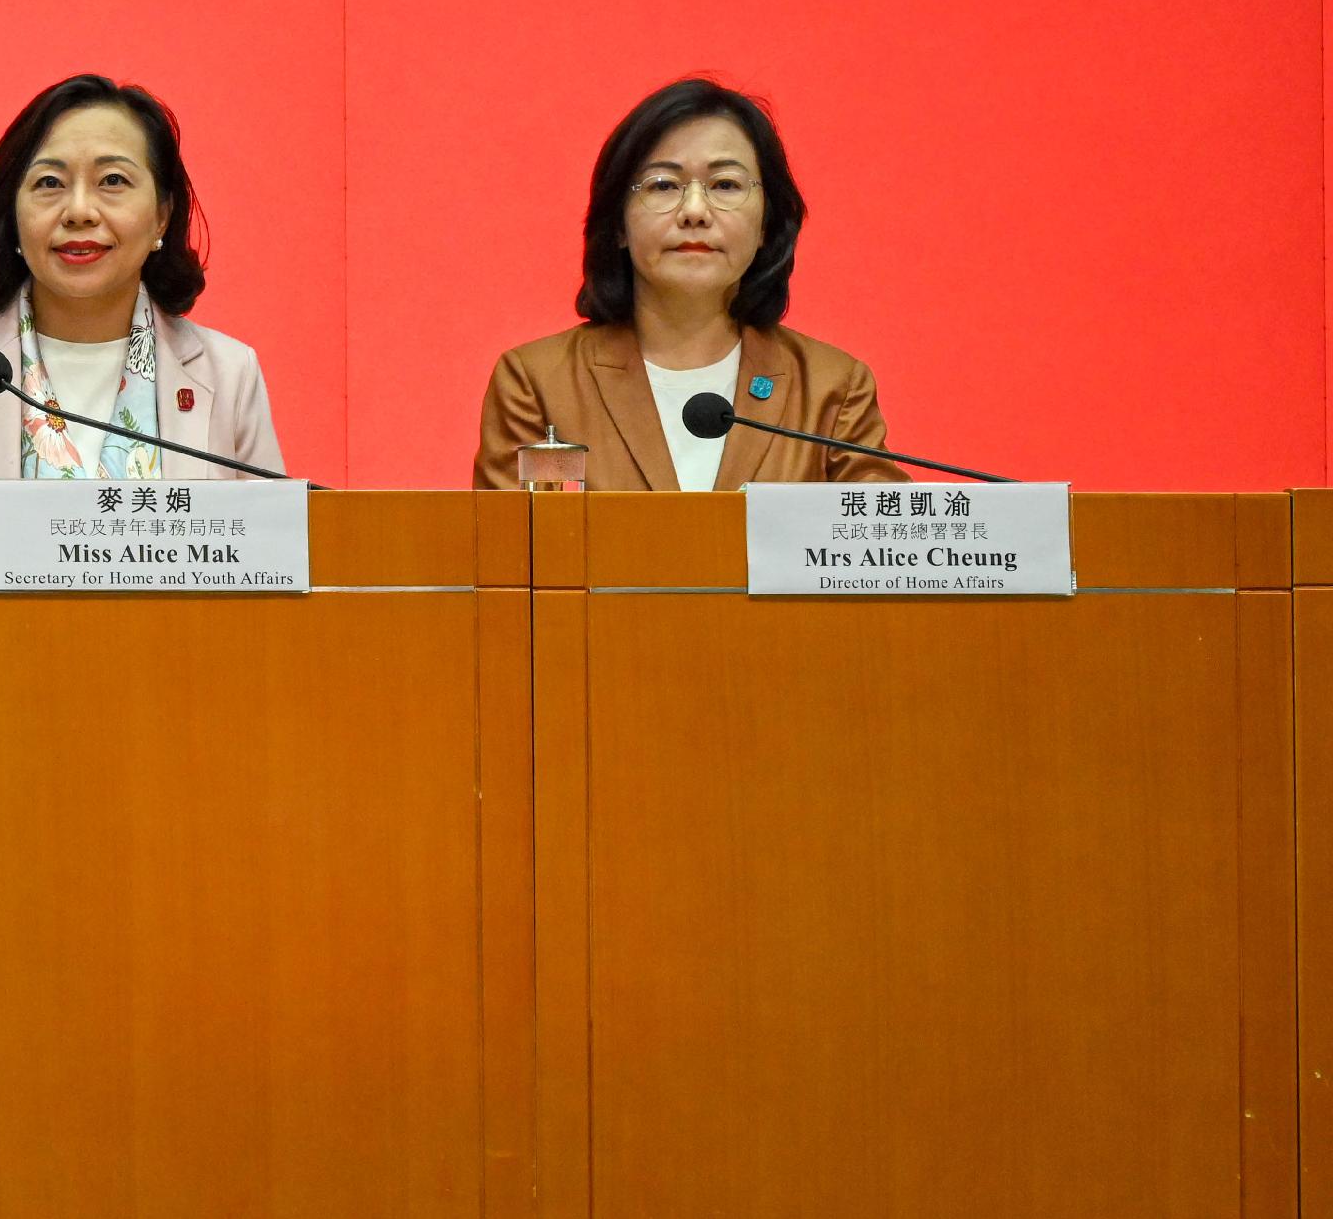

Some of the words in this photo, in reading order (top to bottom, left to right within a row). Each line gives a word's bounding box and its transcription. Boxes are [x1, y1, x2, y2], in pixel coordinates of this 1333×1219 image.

[96, 486, 192, 514] 麥美娟
[840, 490, 971, 517] 張趙凱渝
[50, 518, 246, 537] 民政及青年事務局局長
[832, 522, 989, 541] 民政事務總署署長
[58, 543, 112, 563] Miss
[118, 543, 178, 563] Alice
[186, 543, 240, 563] Mak
[804, 547, 852, 567] Mrs
[858, 547, 919, 567] Alice
[926, 547, 1018, 572] Cheung
[4, 571, 76, 586] Secretary
[82, 571, 104, 585] for
[109, 571, 154, 585] Home
[159, 571, 186, 585] and
[191, 571, 236, 585] Youth
[240, 571, 294, 585] Affairs
[819, 576, 881, 589] Director
[885, 576, 902, 589] of
[906, 576, 948, 589] Home
[953, 576, 1004, 589] Affairs
